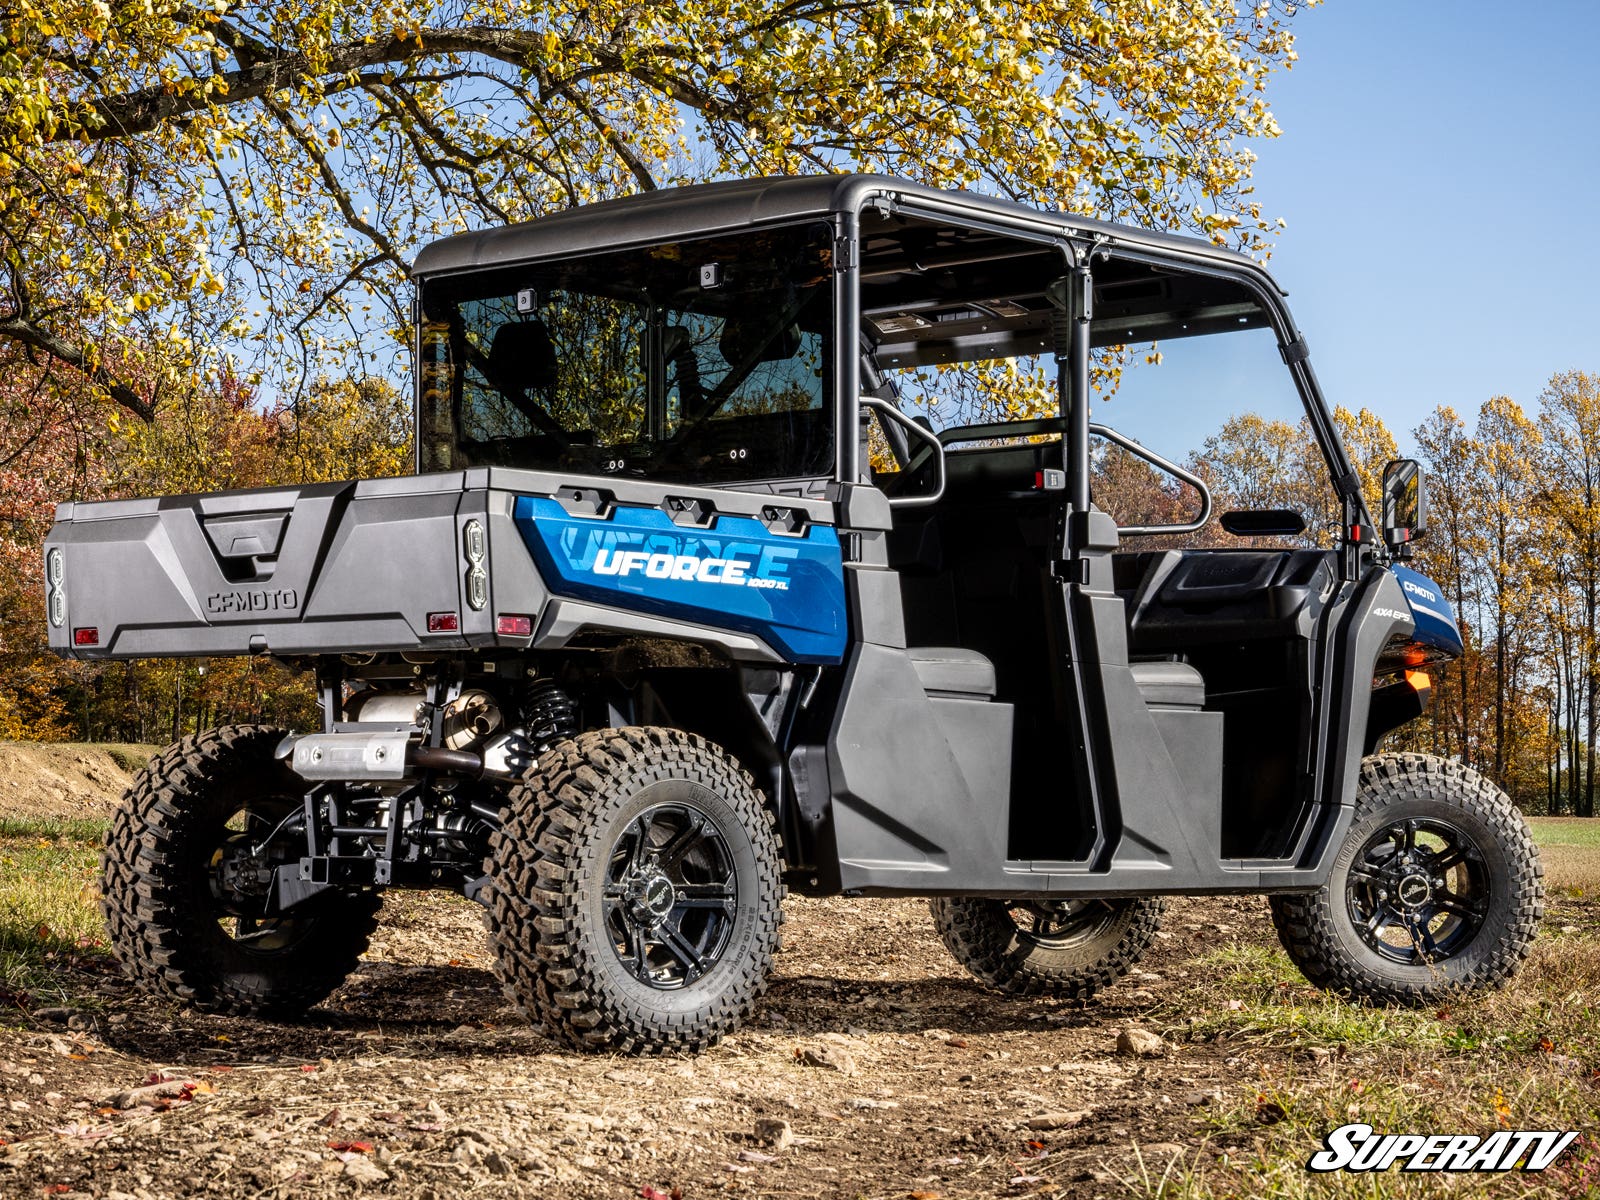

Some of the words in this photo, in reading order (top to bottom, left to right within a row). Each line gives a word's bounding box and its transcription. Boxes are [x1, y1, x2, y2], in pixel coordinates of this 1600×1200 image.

[593, 549, 751, 585] UFORCE
[747, 578, 776, 589] 1000
[775, 581, 789, 590] XL
[207, 589, 298, 613] CFMOTO
[1404, 581, 1436, 602] CFMOTO
[1392, 610, 1411, 622] EPS
